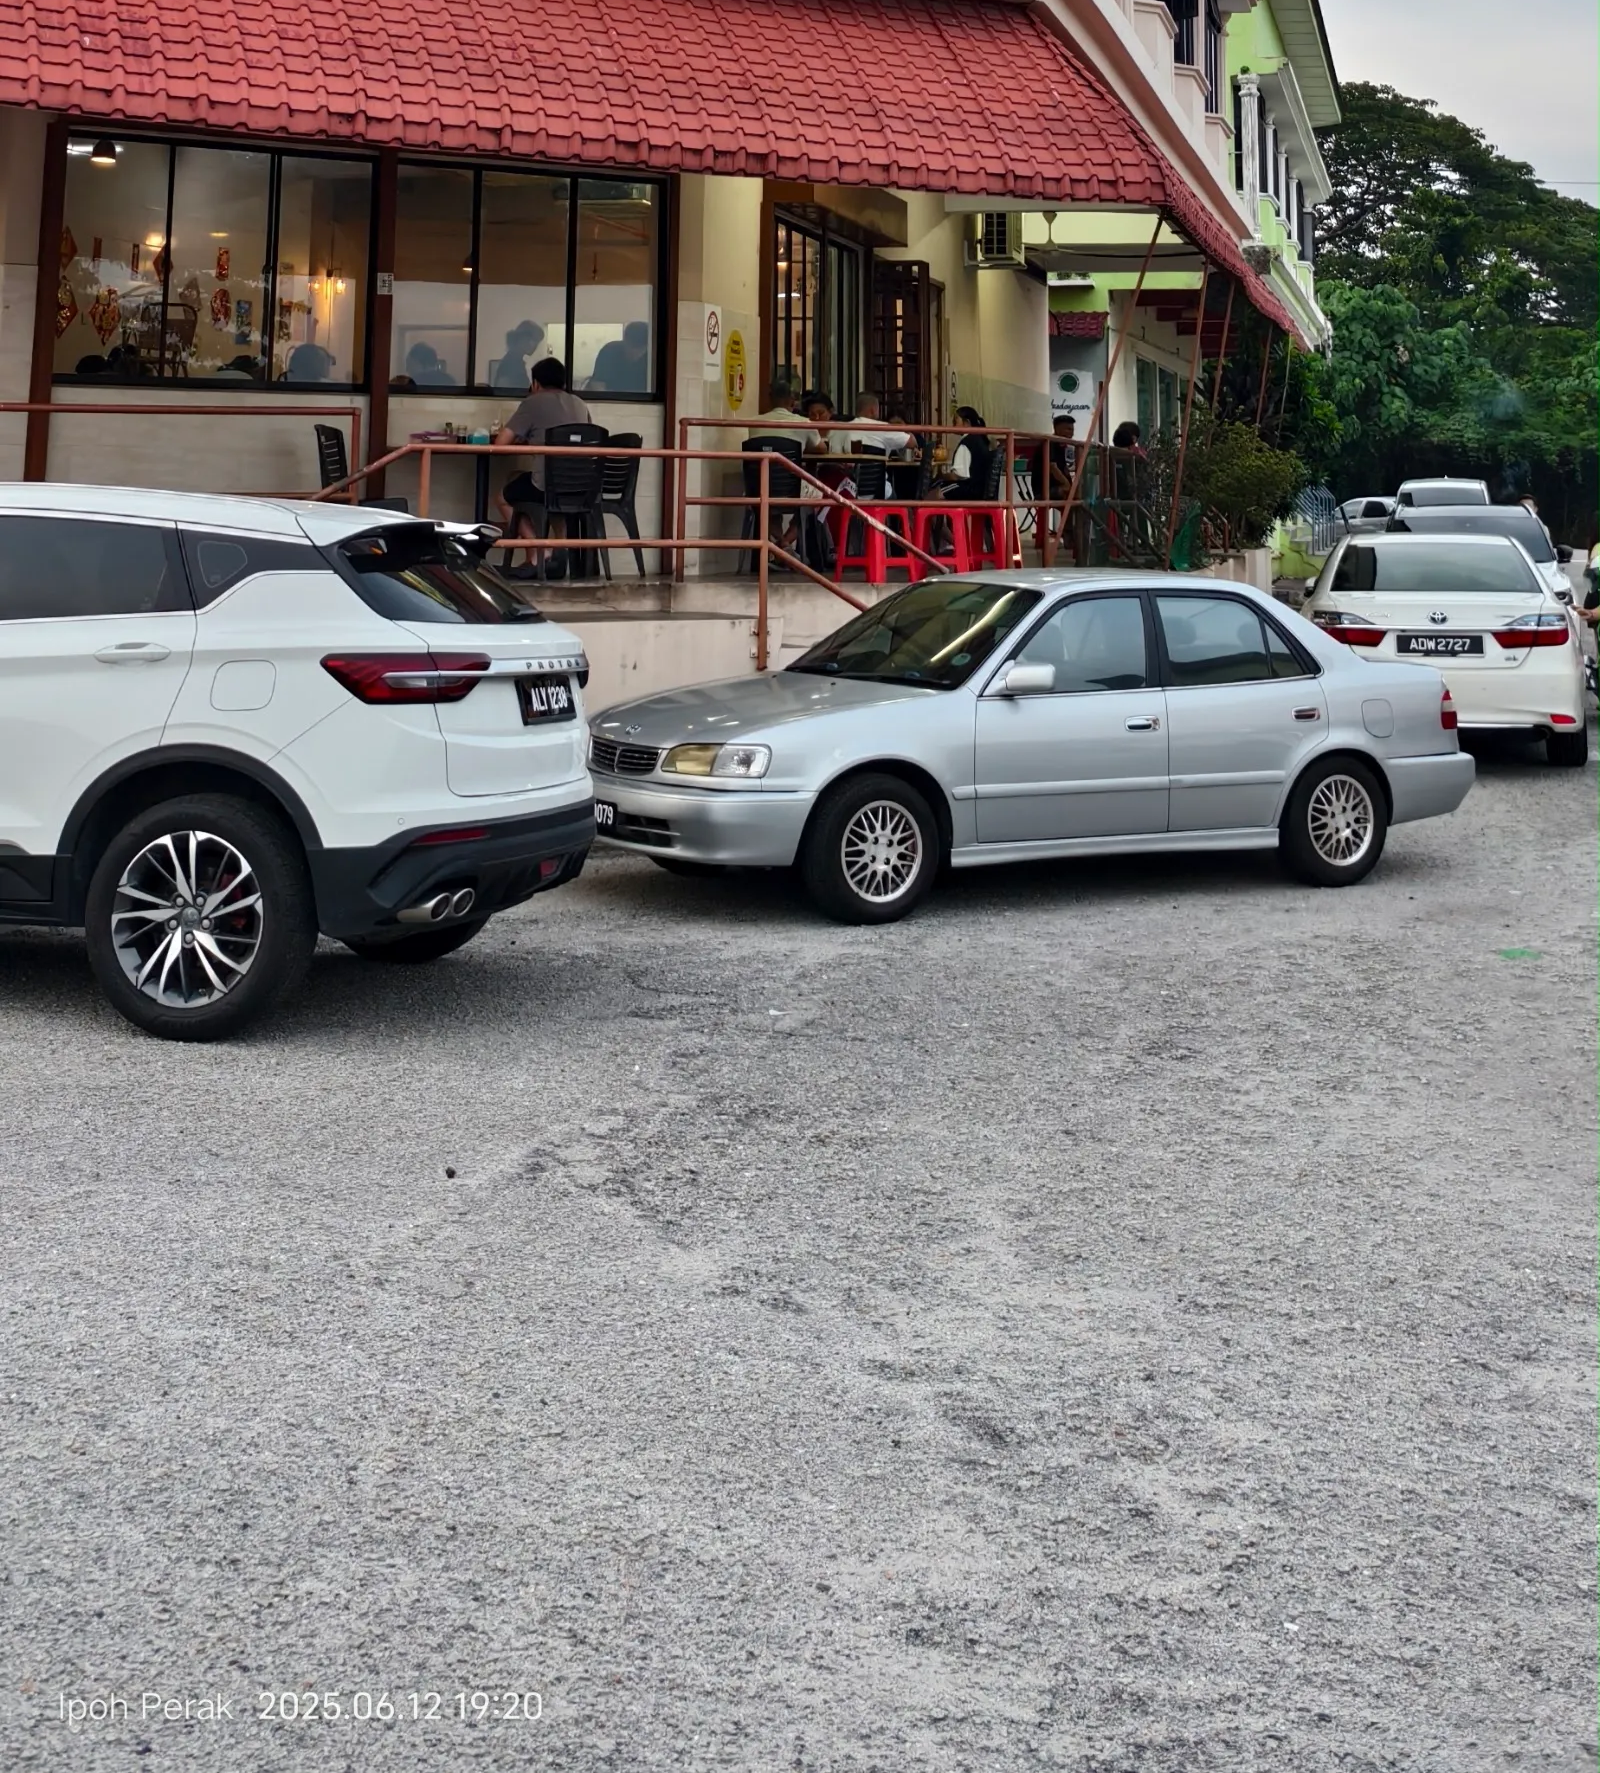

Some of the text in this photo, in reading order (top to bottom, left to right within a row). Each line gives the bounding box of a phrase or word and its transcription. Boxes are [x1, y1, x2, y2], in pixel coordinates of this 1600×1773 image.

[1409, 638, 1471, 651] ADW 2727
[526, 659, 580, 670] PROTON
[531, 687, 548, 712] ALY
[594, 803, 613, 825] 079
